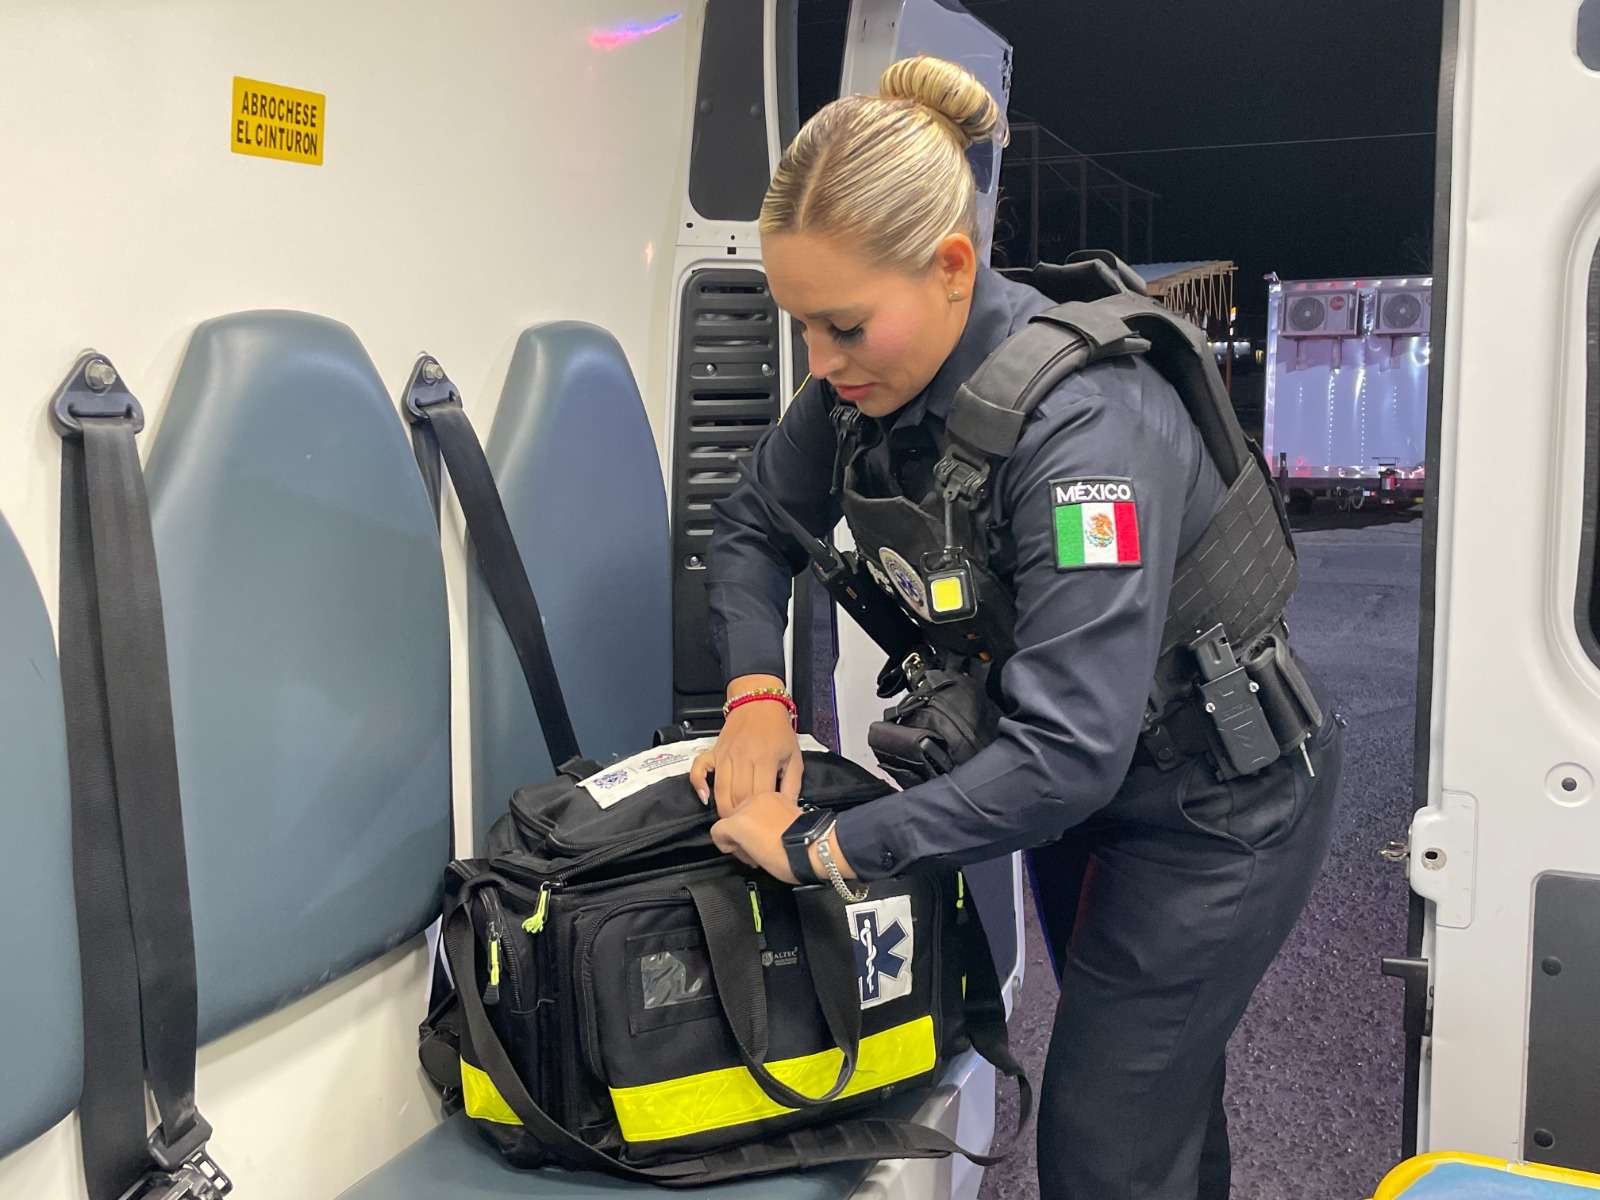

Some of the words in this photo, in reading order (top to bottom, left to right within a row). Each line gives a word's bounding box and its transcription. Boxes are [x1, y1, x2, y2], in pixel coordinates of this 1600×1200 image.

[241, 91, 317, 128] ABROCHESE
[236, 119, 252, 144] EL
[255, 123, 318, 157] CINTURON
[1055, 482, 1131, 503] MÉXICO
